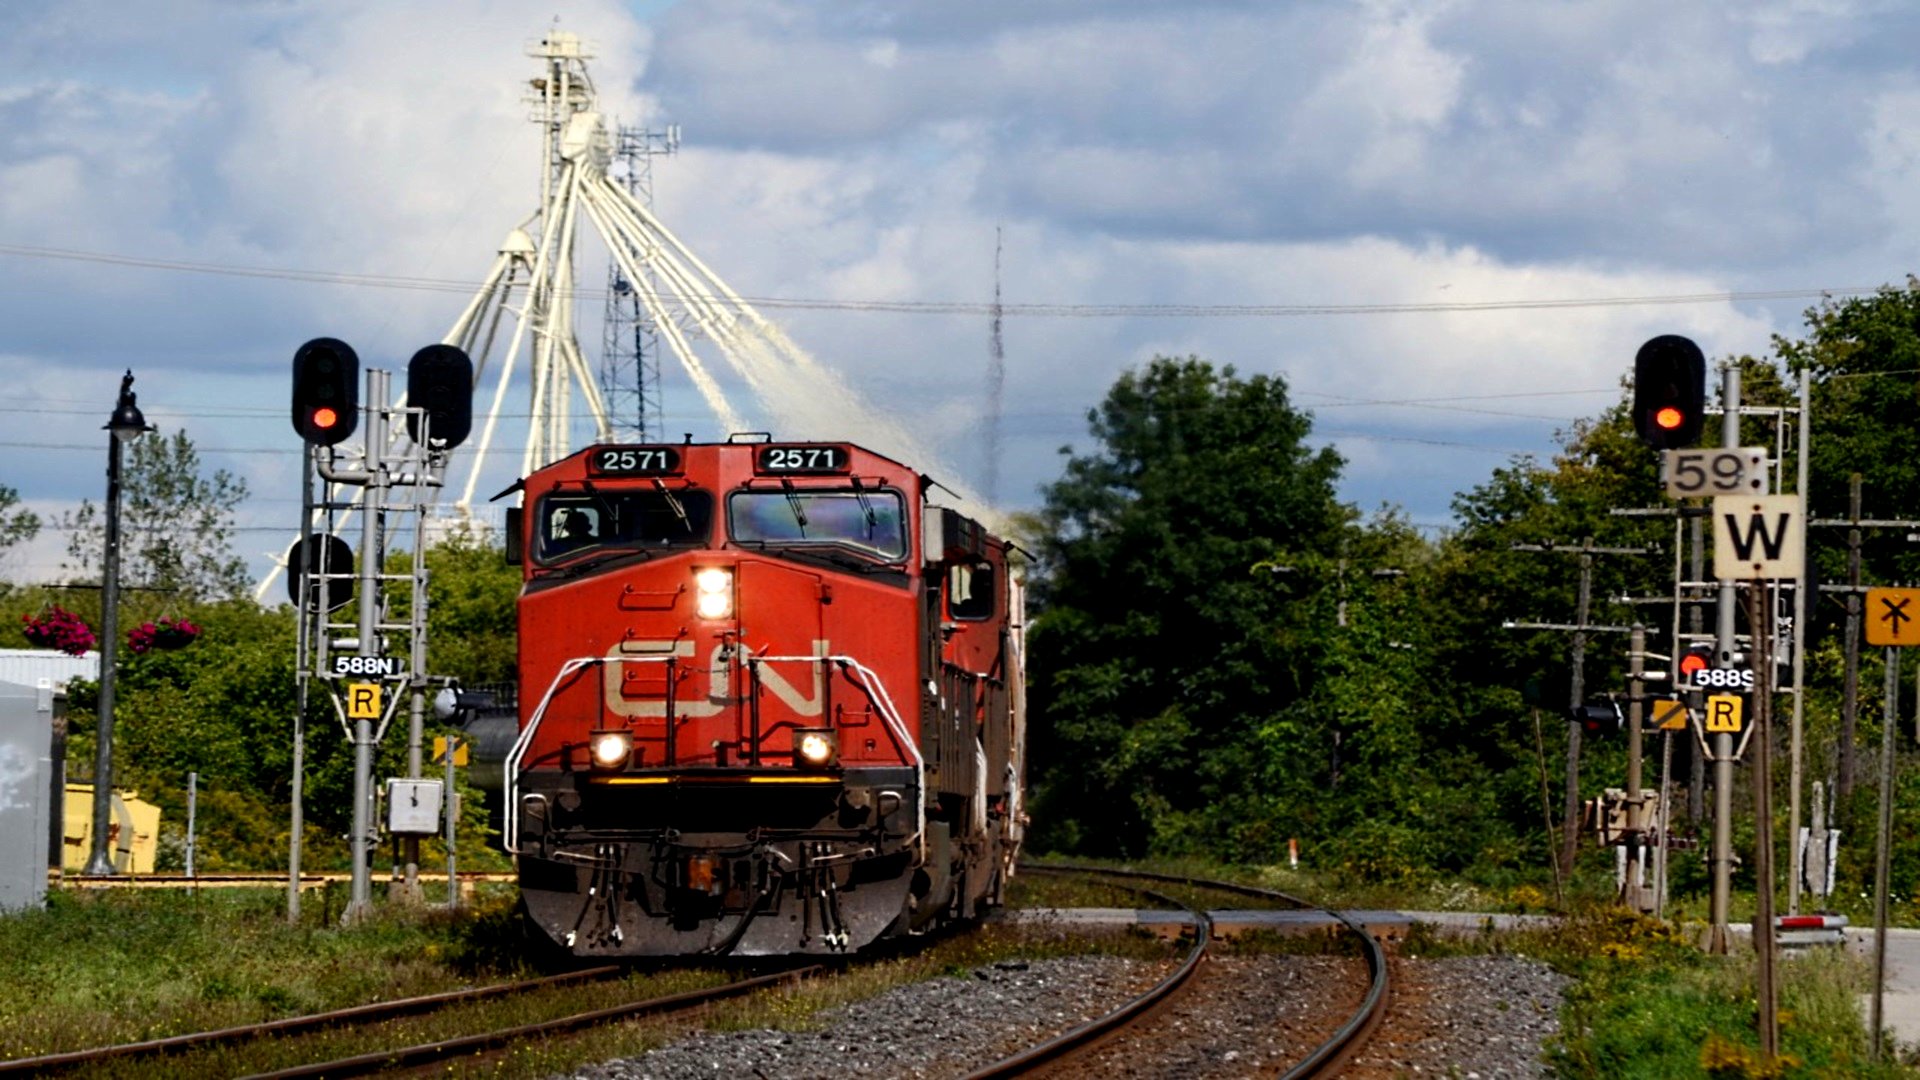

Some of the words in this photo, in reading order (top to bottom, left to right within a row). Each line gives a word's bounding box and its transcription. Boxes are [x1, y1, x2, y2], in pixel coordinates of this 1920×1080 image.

[603, 451, 667, 470] 2571
[769, 449, 834, 469] 2571
[1674, 453, 1744, 492] 59
[1725, 512, 1790, 561] W
[335, 656, 393, 674] 588N
[605, 640, 830, 717] CN
[1696, 669, 1754, 687] 588S
[354, 689, 374, 713] R
[1714, 701, 1734, 727] R
